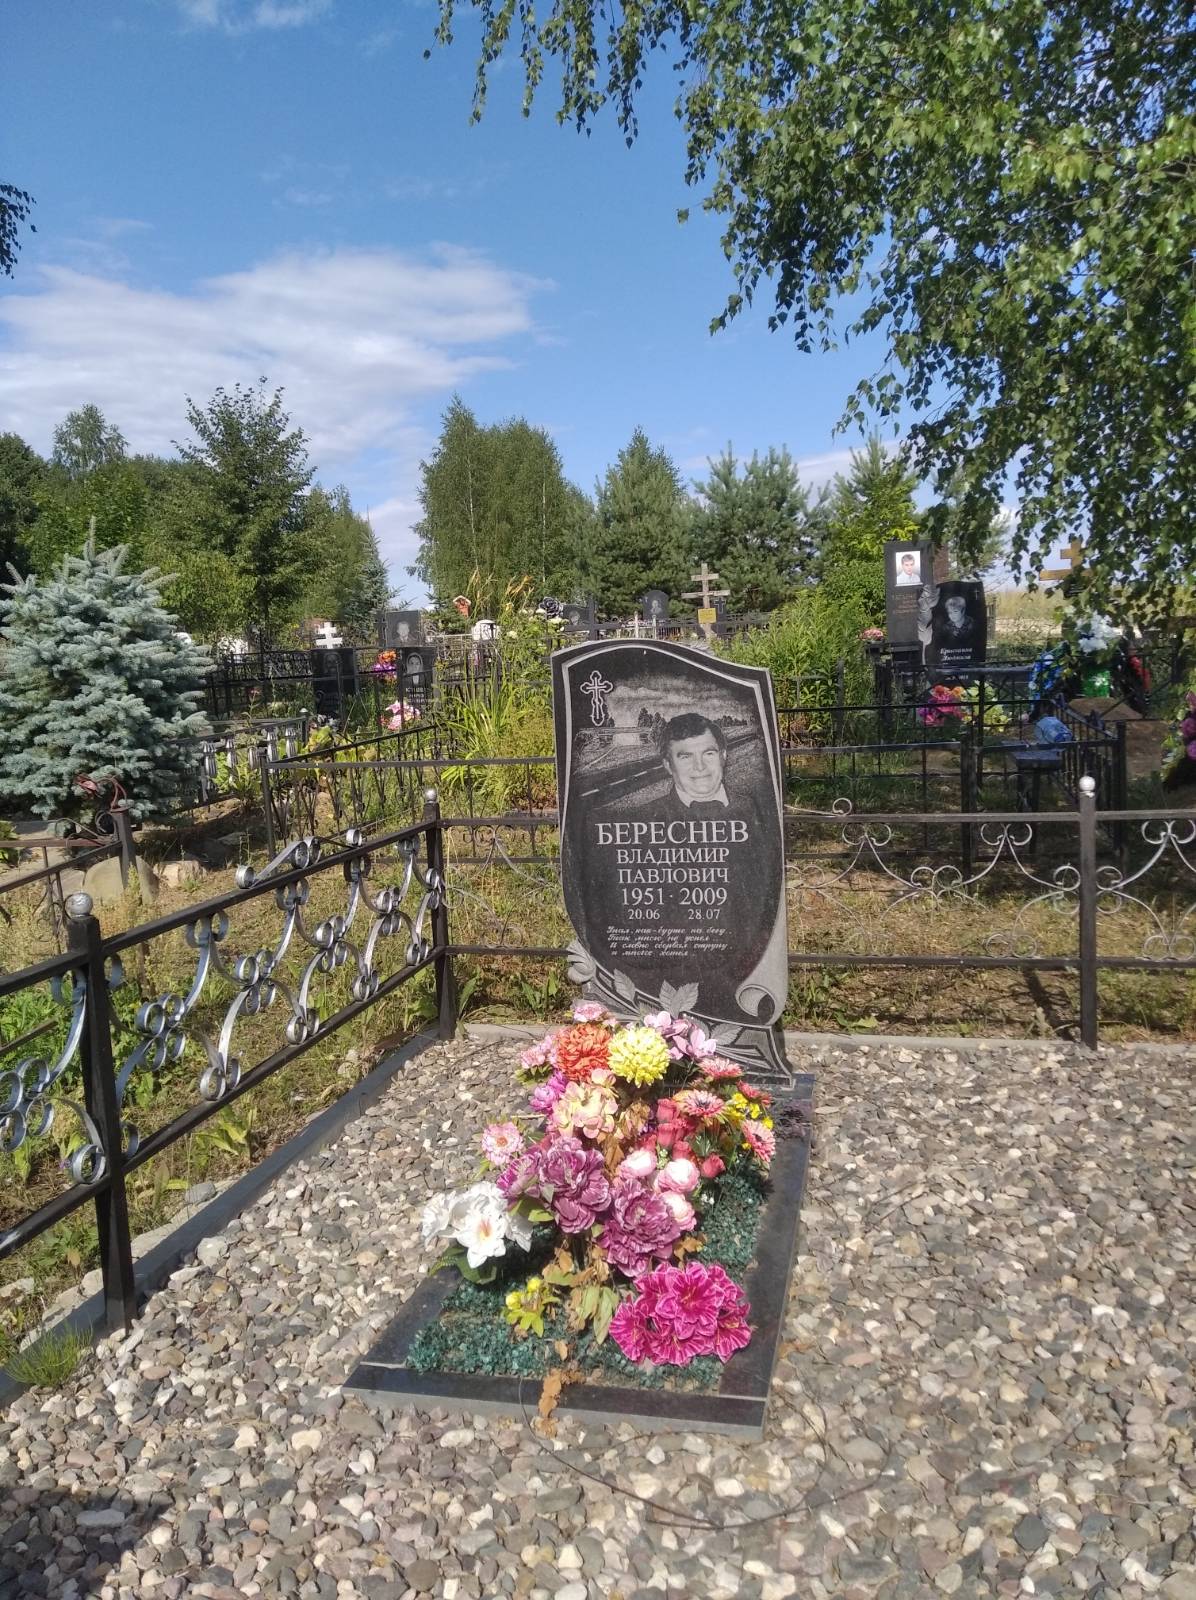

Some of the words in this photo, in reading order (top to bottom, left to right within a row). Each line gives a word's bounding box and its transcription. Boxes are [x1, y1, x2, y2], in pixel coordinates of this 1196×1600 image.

[595, 820, 749, 845] БЕРЕСНЕВ
[616, 847, 730, 867] ВЛАДИМИР
[616, 867, 731, 884] ПАВЛОВИЧ
[621, 887, 665, 906] 1951
[679, 887, 728, 906] 2009
[628, 909, 661, 920] 20.06
[687, 909, 721, 920] 28.07
